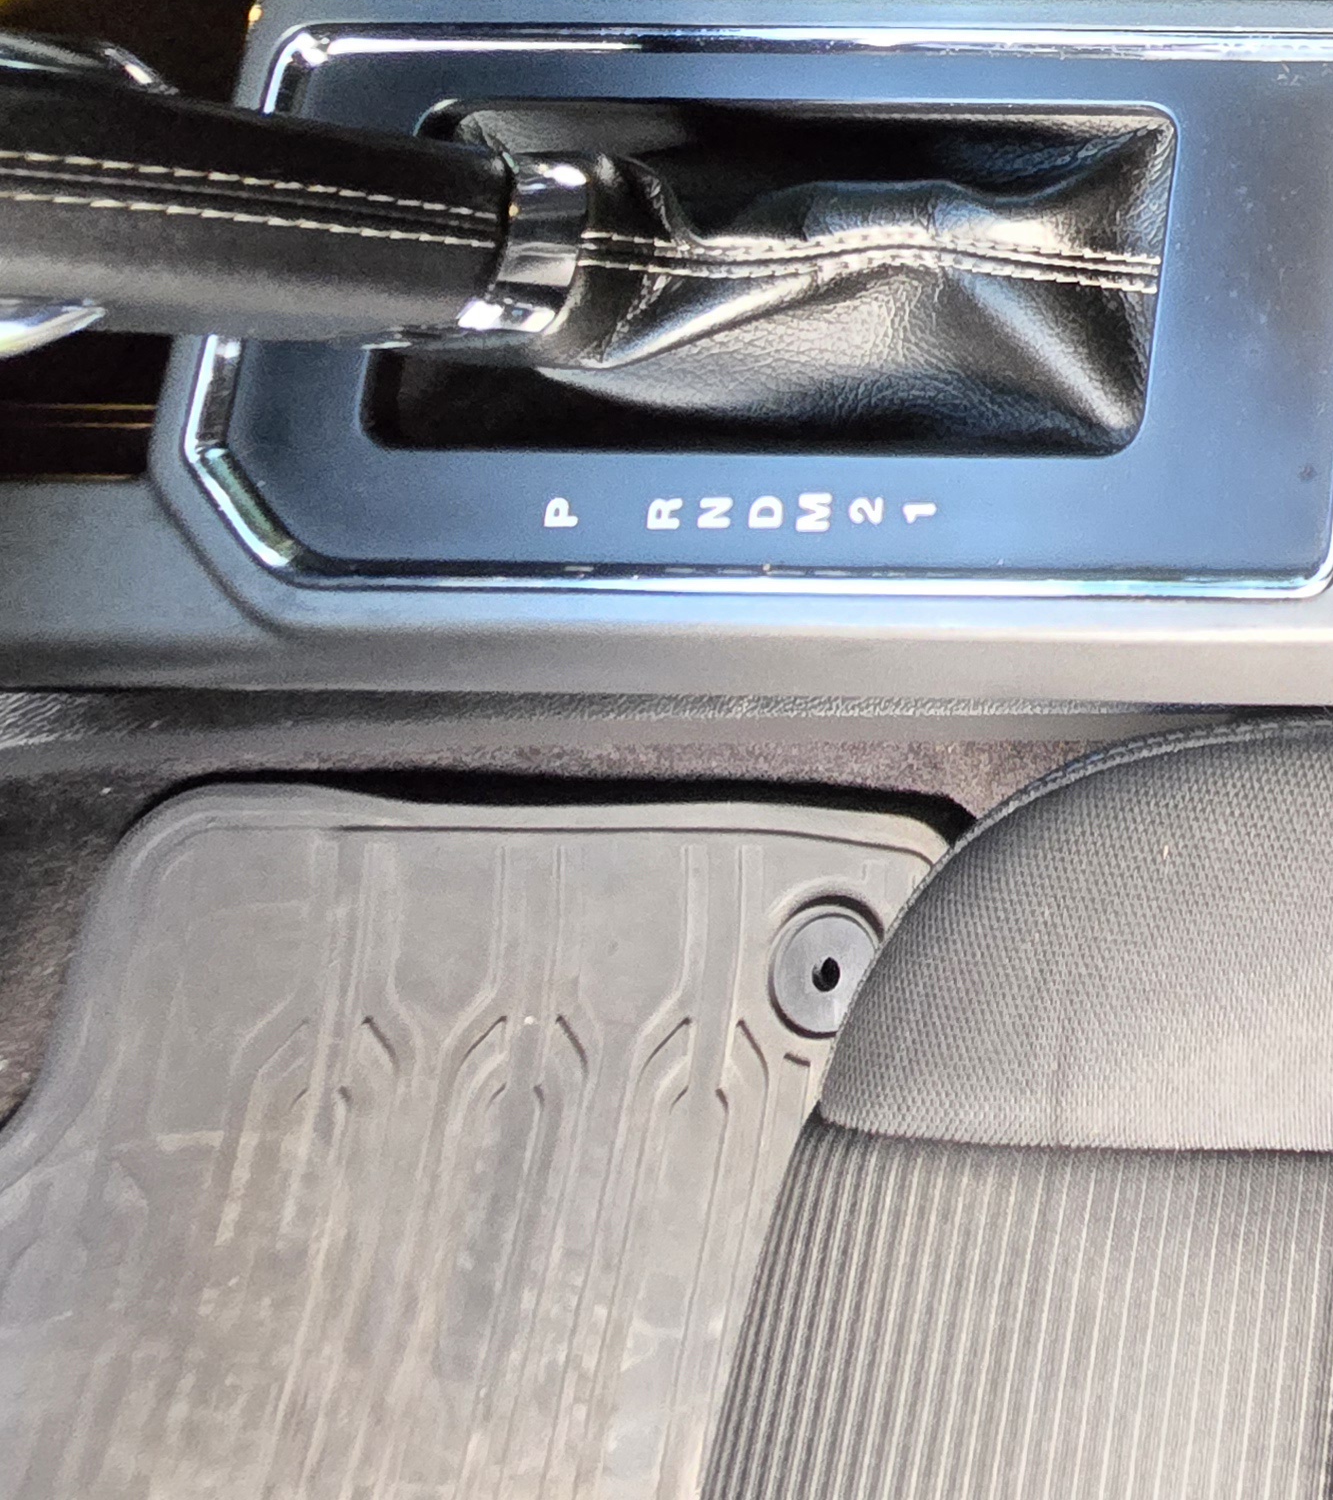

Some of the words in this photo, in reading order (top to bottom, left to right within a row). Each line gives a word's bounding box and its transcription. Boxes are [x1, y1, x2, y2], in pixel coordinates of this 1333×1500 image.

[543, 497, 579, 528] P
[646, 498, 684, 530] R
[696, 497, 734, 529] N
[748, 495, 784, 529] D
[795, 492, 833, 533] M
[849, 496, 885, 526] 2
[902, 501, 938, 525] 1
